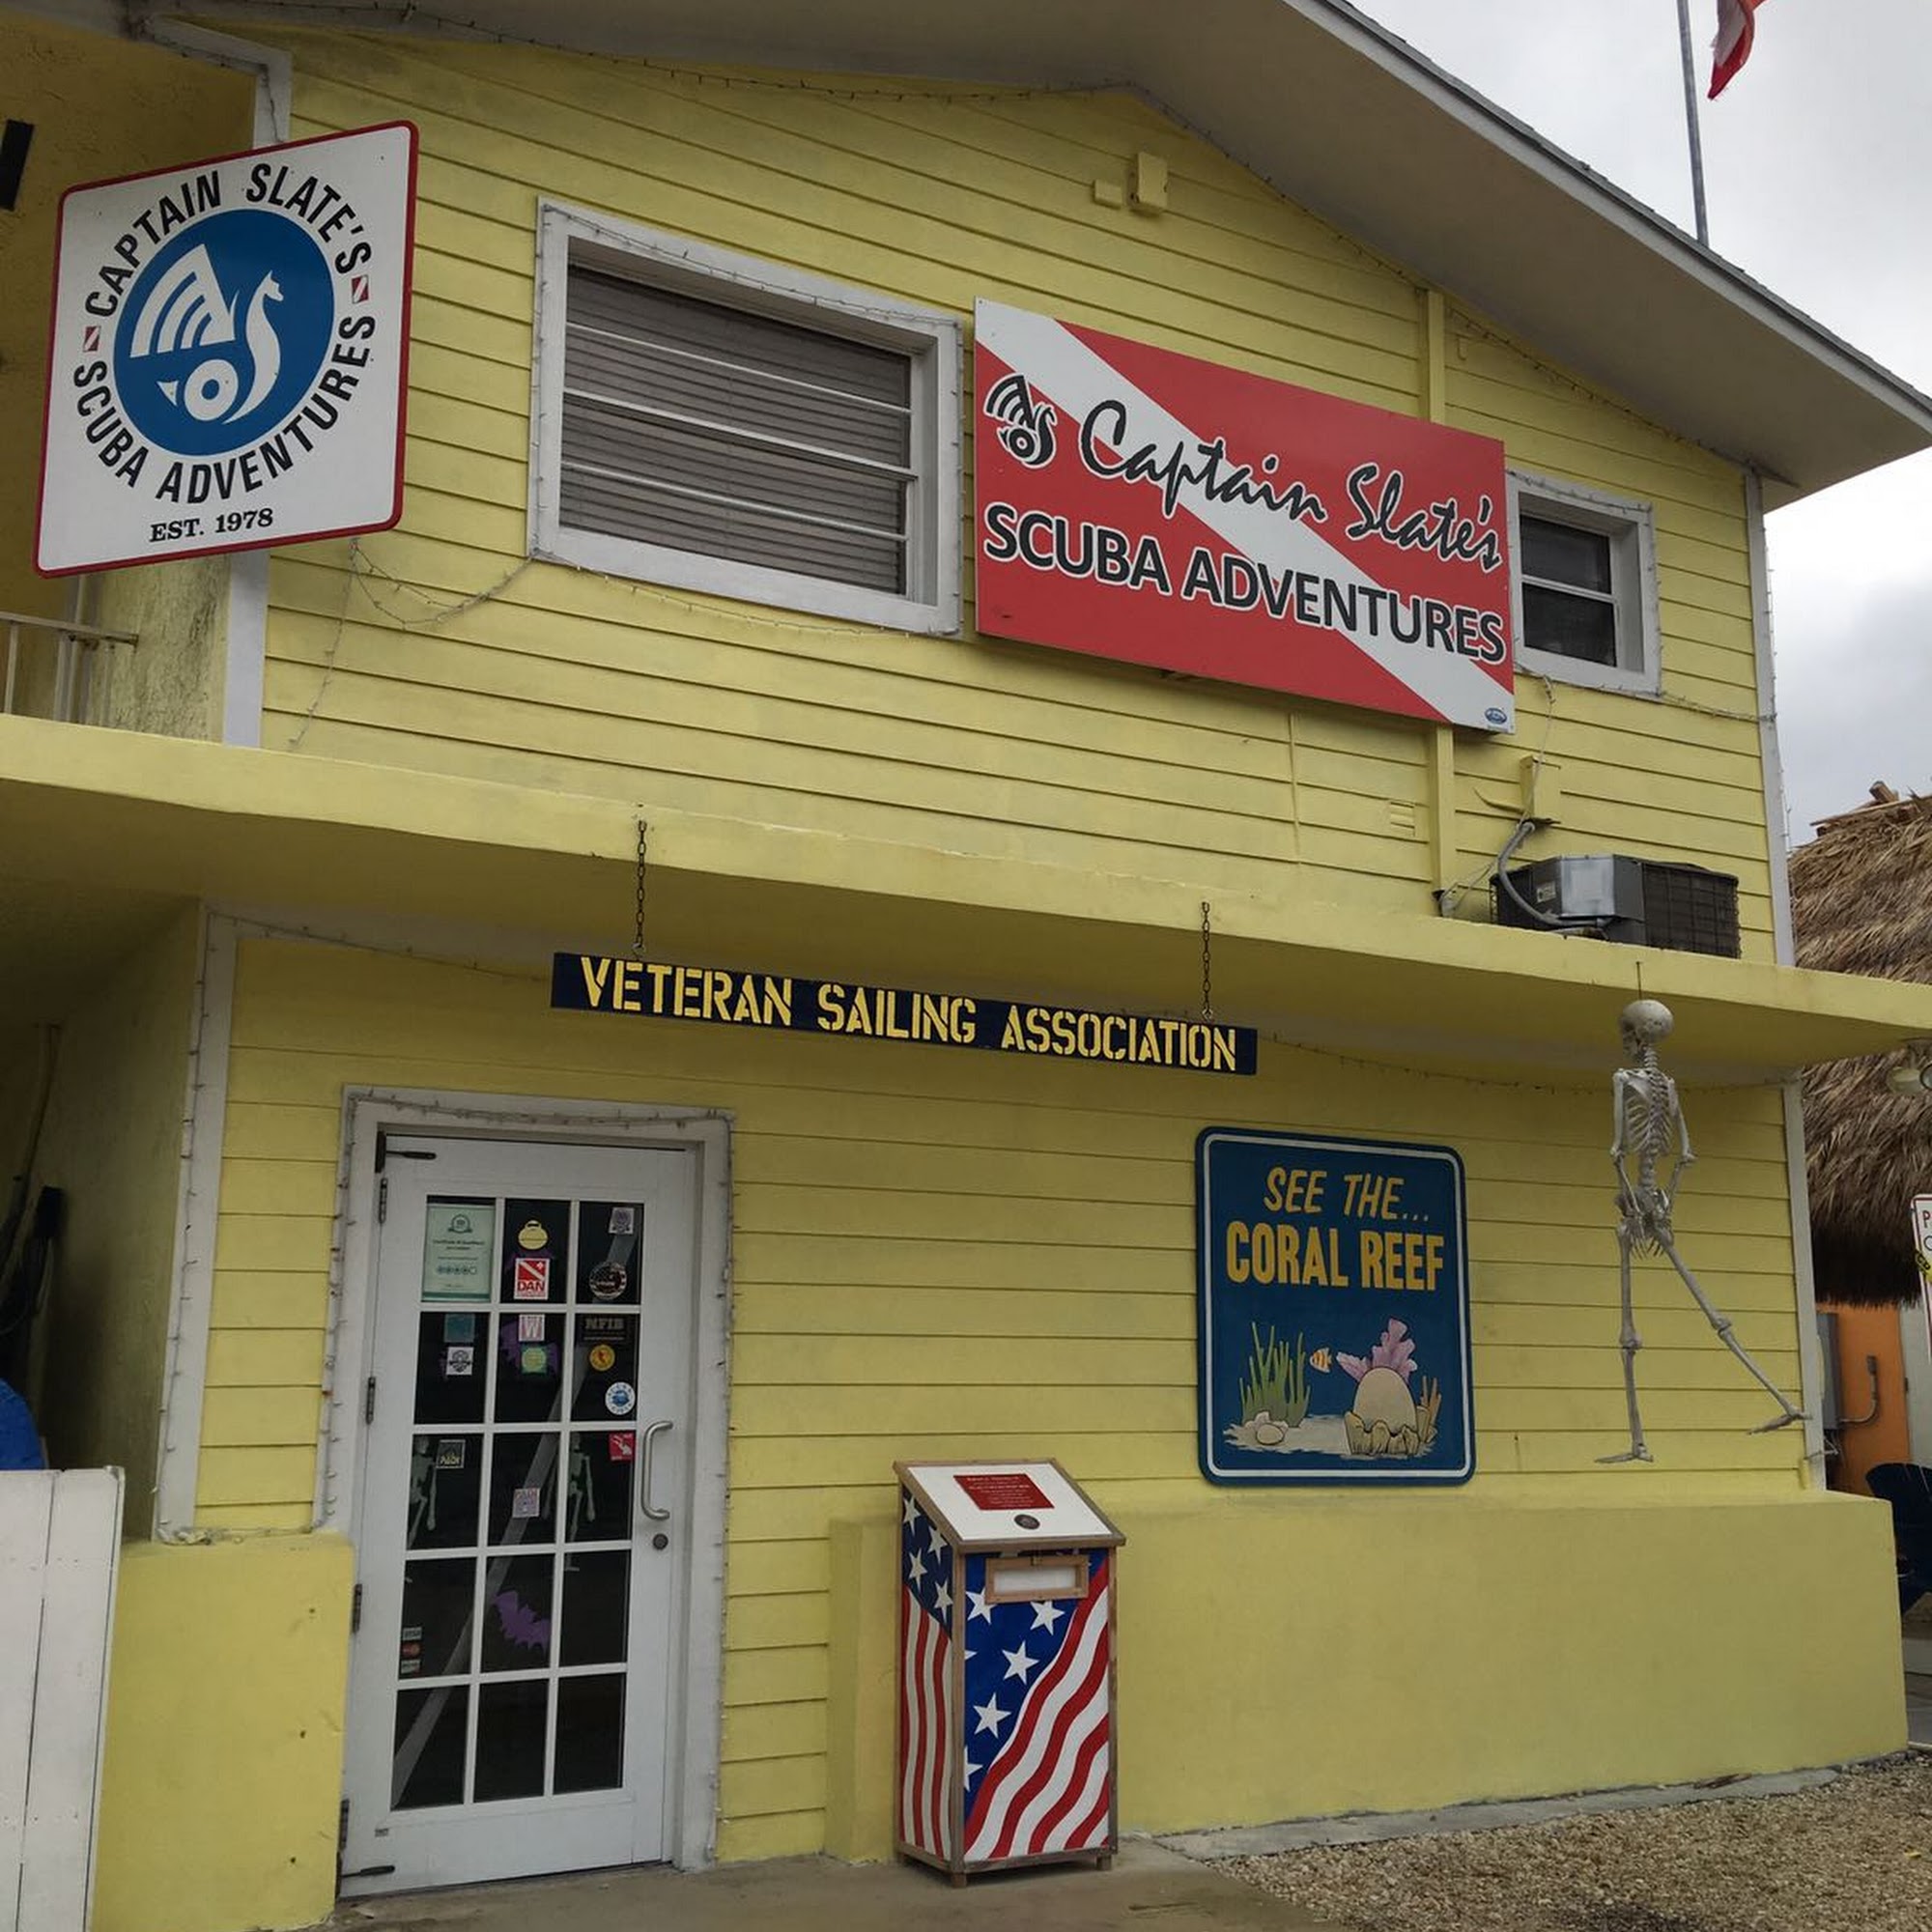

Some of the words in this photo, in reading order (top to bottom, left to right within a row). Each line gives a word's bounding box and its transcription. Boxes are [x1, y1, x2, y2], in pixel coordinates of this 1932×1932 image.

[85, 170, 220, 318] CAPTAIN
[245, 162, 372, 274] SLATE'S
[73, 359, 150, 488] SCUBA
[156, 315, 376, 504] ADVENTURES
[148, 519, 205, 543] EST.
[214, 507, 273, 533] 1978
[1079, 399, 1328, 520] Captain
[1347, 464, 1503, 572] Slate's
[984, 503, 1171, 594] SCUBA
[1183, 549, 1506, 664] ADVENTURES
[580, 955, 792, 1026] VETERAN
[817, 983, 977, 1044] SAILING
[1000, 1005, 1236, 1071] ASSOCIATION
[1264, 1167, 1327, 1214] SEE
[518, 1281, 546, 1293] DAN
[1226, 1220, 1349, 1288] CORAL
[1360, 1230, 1445, 1292] REEF
